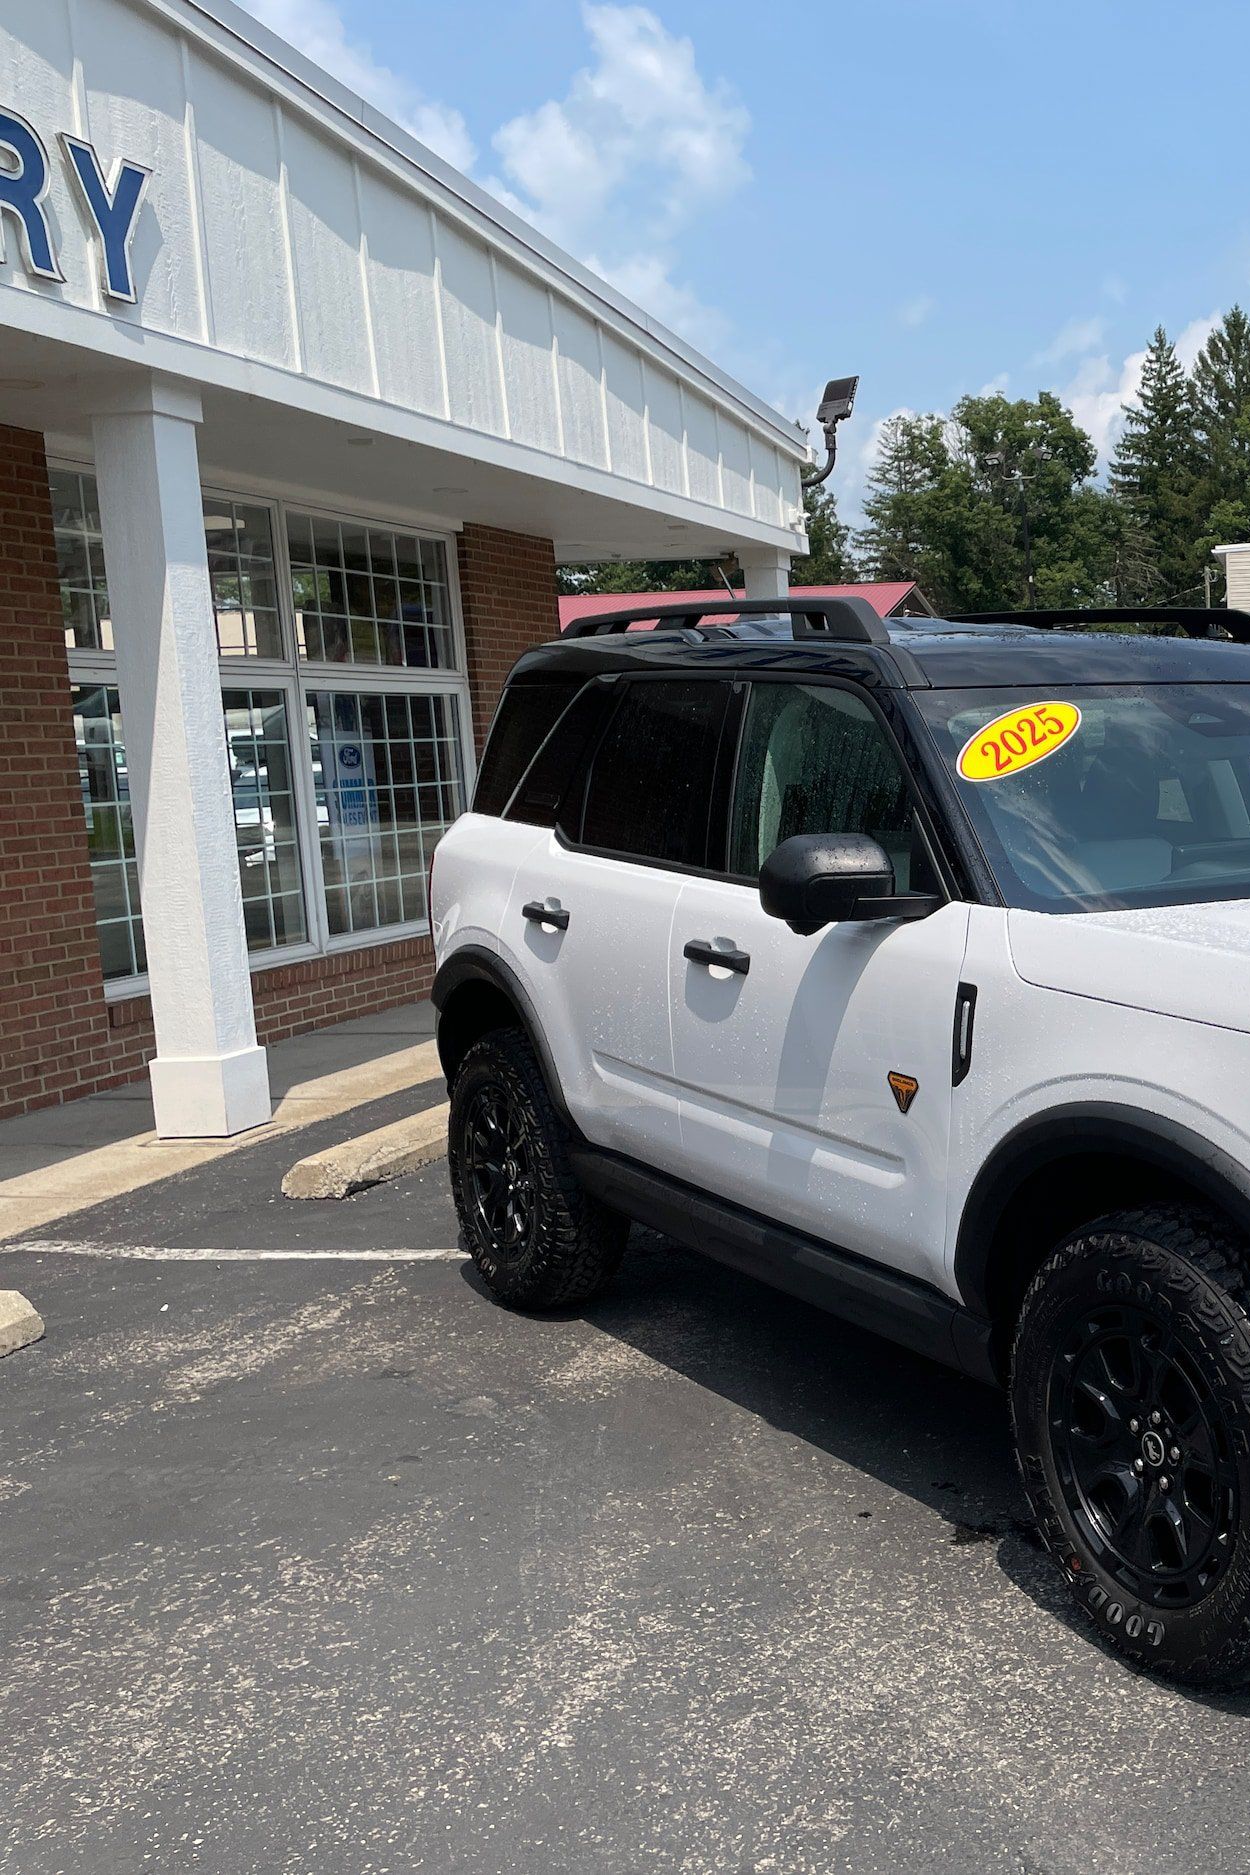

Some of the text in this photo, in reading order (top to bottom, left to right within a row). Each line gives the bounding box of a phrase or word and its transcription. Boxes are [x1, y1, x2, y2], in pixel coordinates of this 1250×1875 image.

[0, 105, 153, 304] RY
[981, 707, 1064, 771] 2025
[333, 778, 376, 809] UMMR
